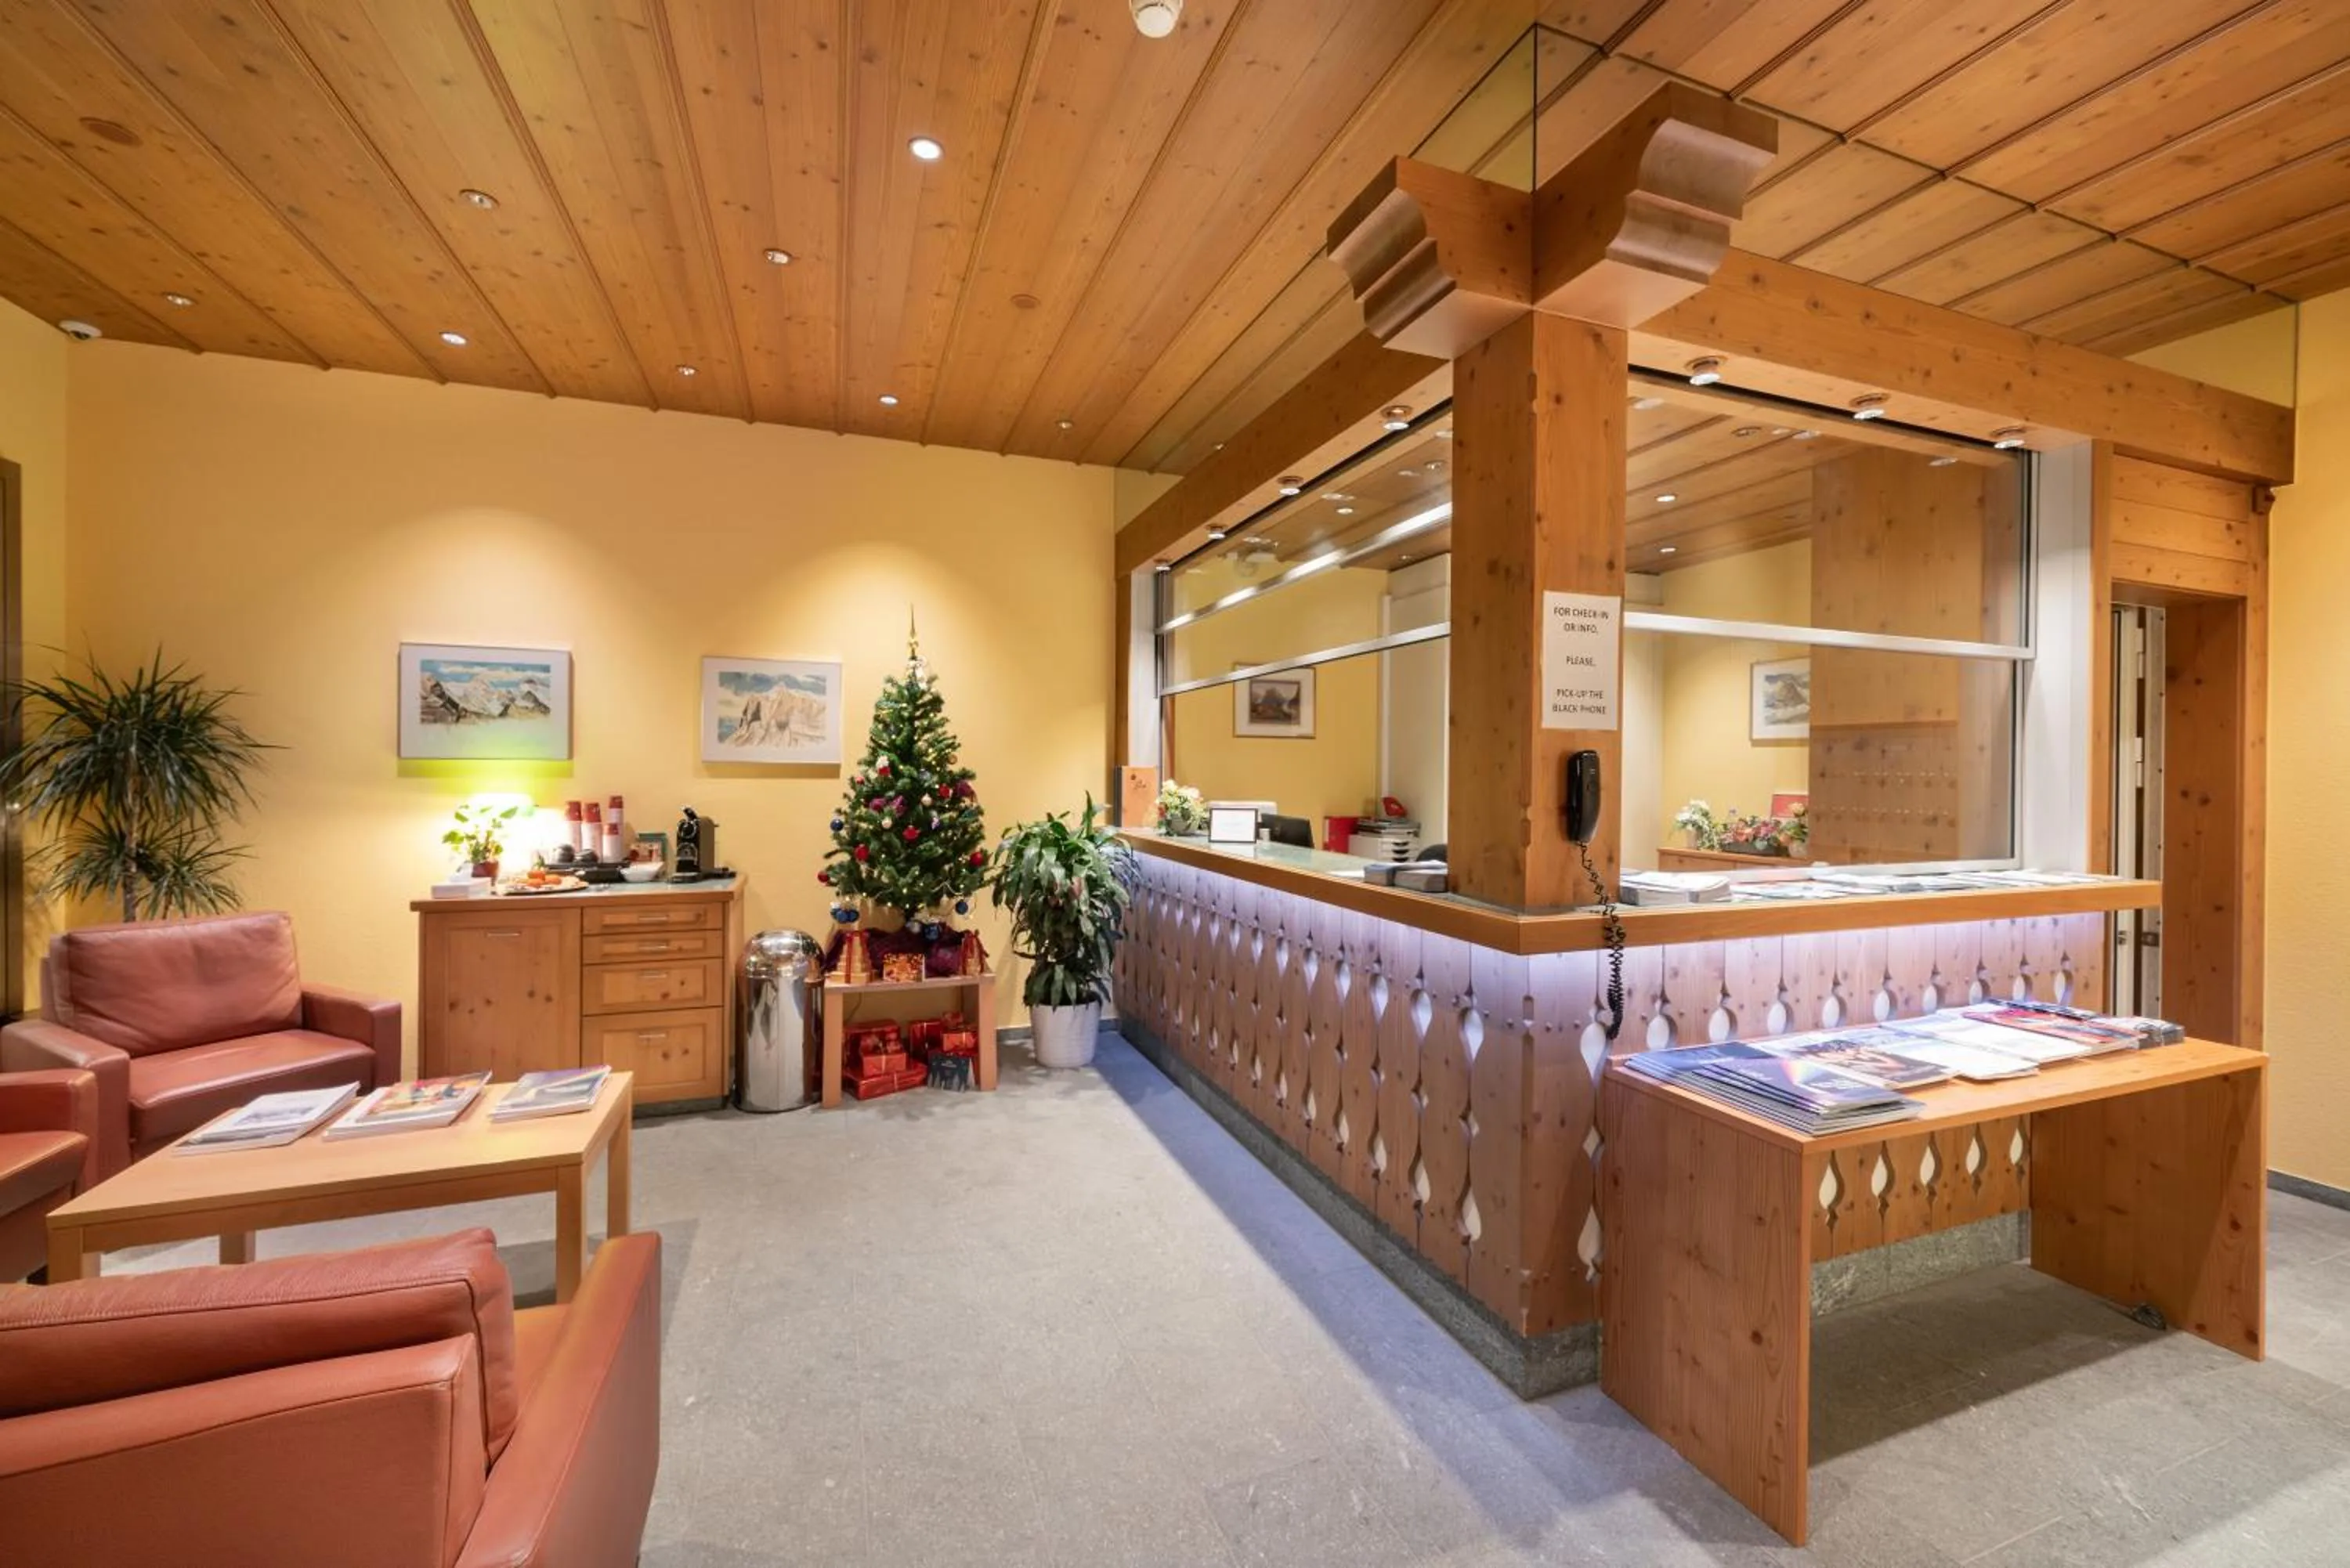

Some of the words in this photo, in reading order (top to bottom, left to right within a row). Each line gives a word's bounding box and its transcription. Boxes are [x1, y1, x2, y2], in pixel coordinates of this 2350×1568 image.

[1553, 608, 1571, 617] FOR
[1564, 623, 1575, 633] OR
[1589, 690, 1604, 699] THE
[1553, 704, 1578, 714] BLACK
[1580, 705, 1607, 715] PHONE
